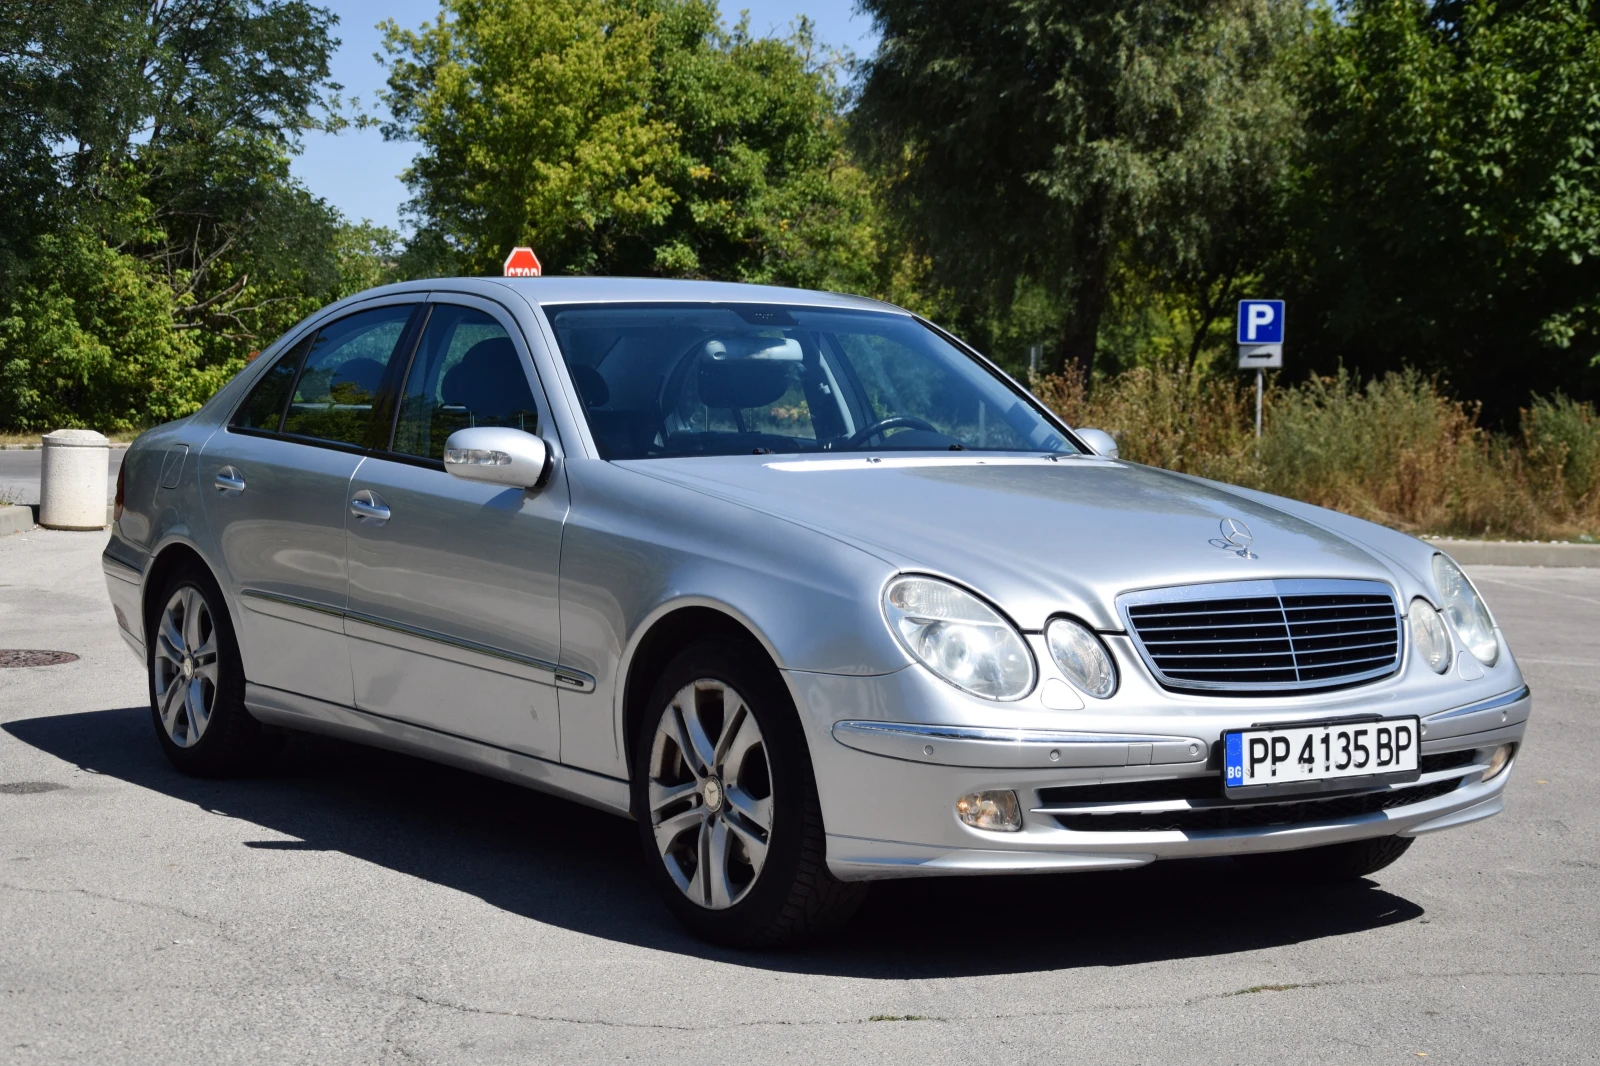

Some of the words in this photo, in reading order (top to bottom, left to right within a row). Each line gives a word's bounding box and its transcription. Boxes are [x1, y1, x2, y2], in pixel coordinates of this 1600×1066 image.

[1247, 304, 1274, 340] P
[1249, 737, 1290, 778] PP
[1298, 729, 1369, 773] 4135
[1376, 725, 1411, 766] BP
[1227, 766, 1242, 779] BG
